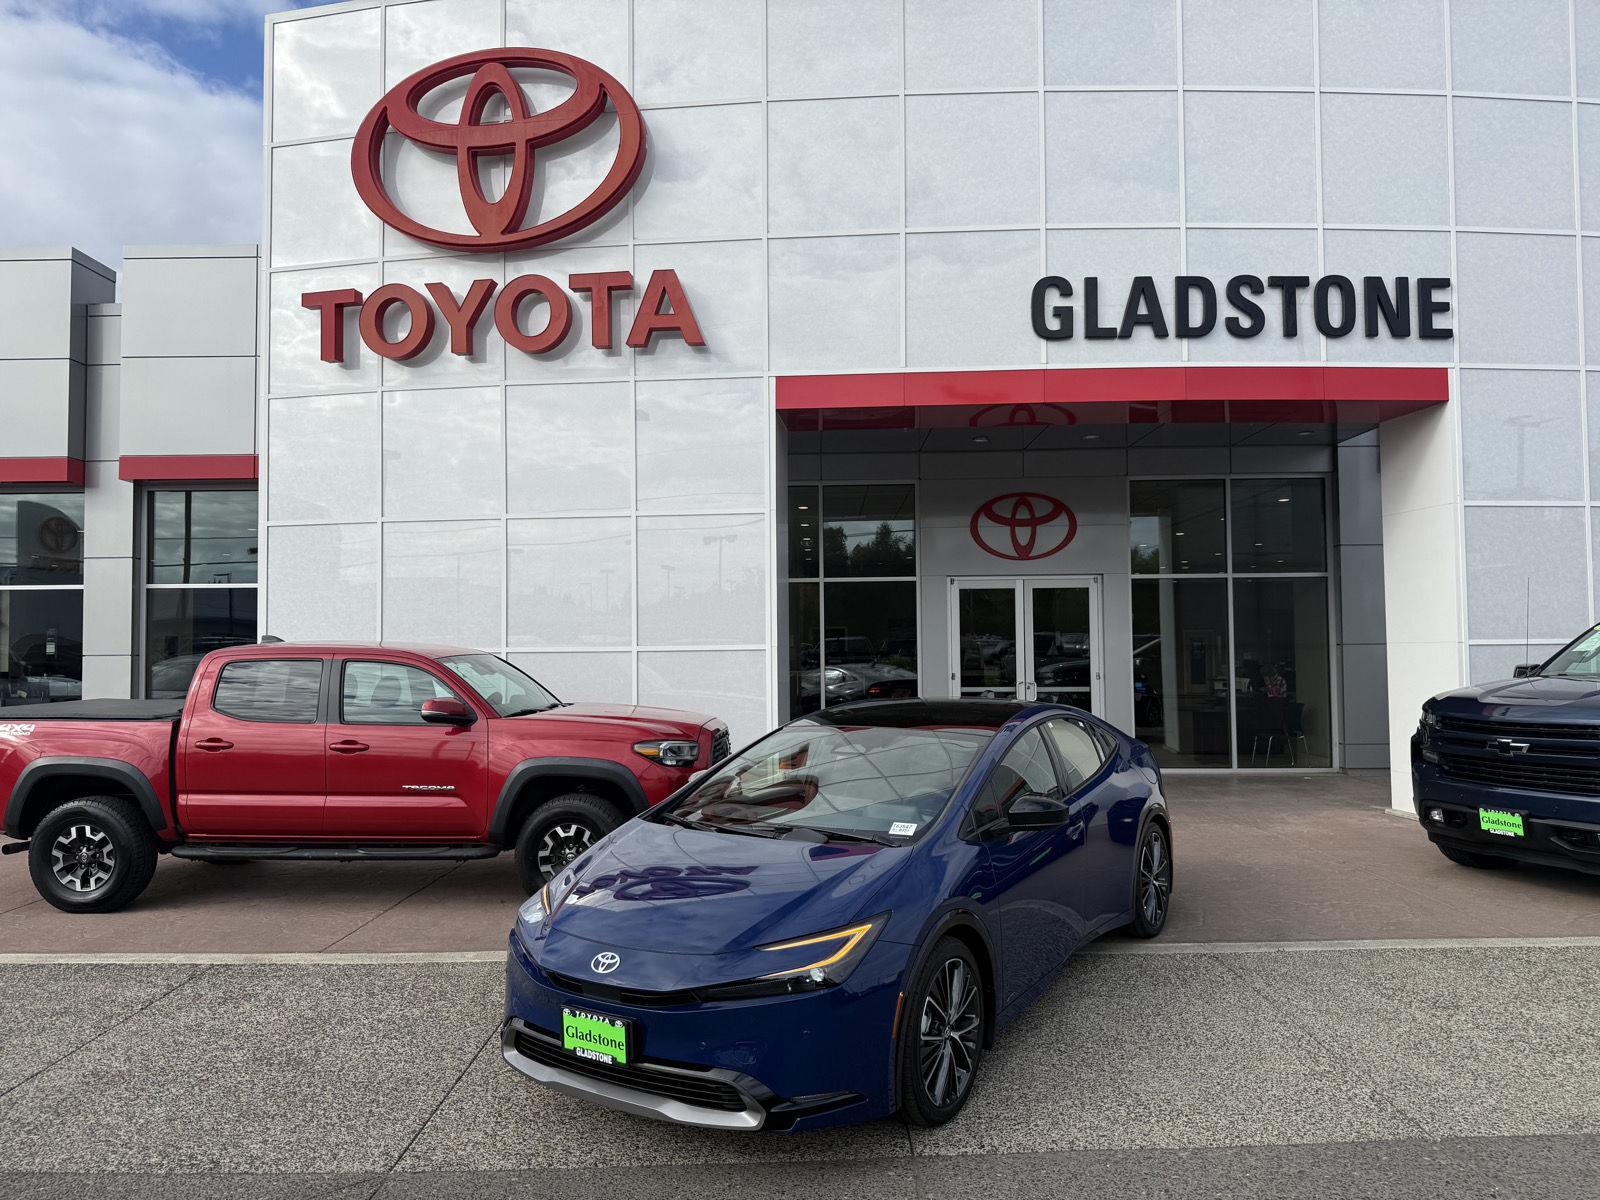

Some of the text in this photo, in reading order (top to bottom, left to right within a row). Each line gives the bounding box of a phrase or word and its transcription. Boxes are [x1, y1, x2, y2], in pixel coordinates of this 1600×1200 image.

[301, 269, 707, 363] TOYOTA
[1030, 274, 1454, 339] GLADSTONE
[1481, 815, 1523, 829] Gladstone
[575, 1011, 610, 1025] TOYOTA
[565, 1025, 625, 1051] Gladstone
[576, 1048, 613, 1064] GLADSTONE
